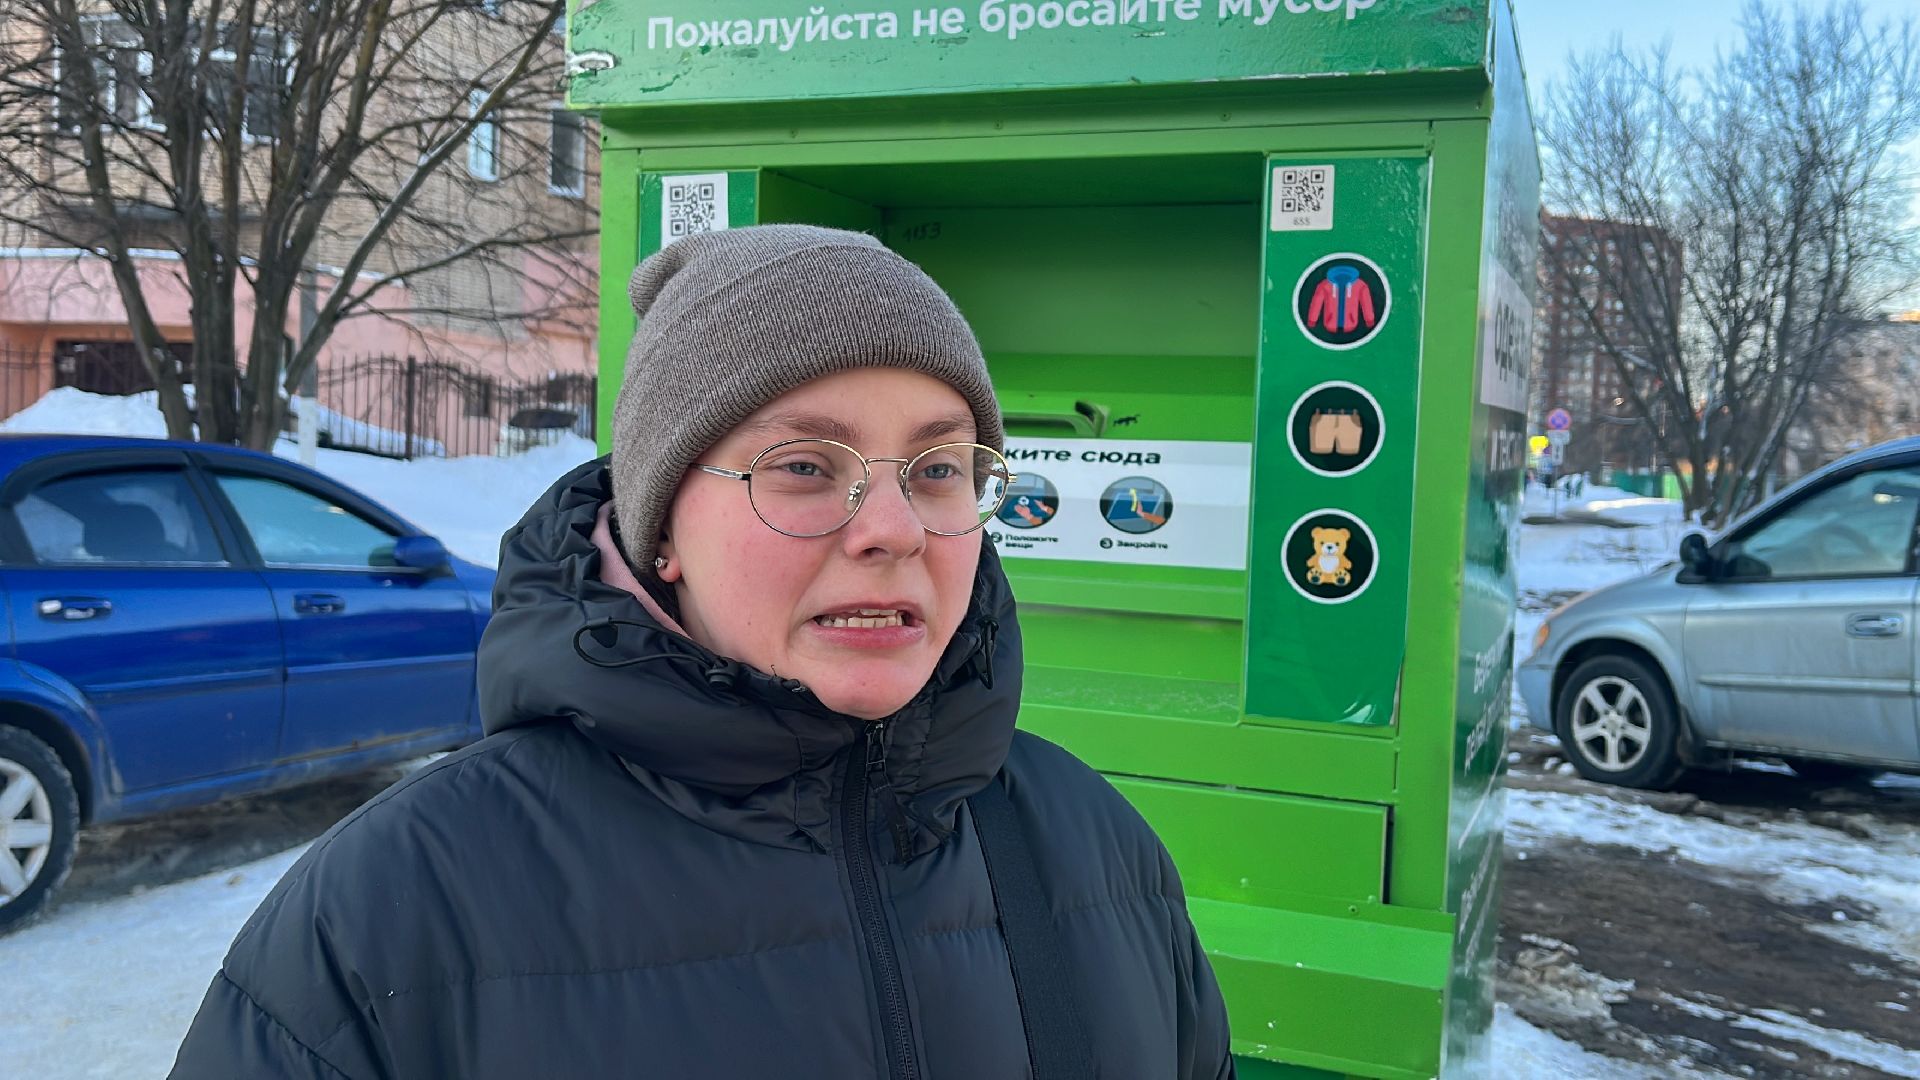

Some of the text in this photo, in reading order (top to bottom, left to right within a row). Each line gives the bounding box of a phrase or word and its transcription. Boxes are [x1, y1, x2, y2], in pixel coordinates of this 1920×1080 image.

[647, 6, 898, 52] Пожалуйста
[912, 7, 965, 37] не
[1218, 0, 1377, 25] мусор
[1081, 450, 1161, 464] сюда
